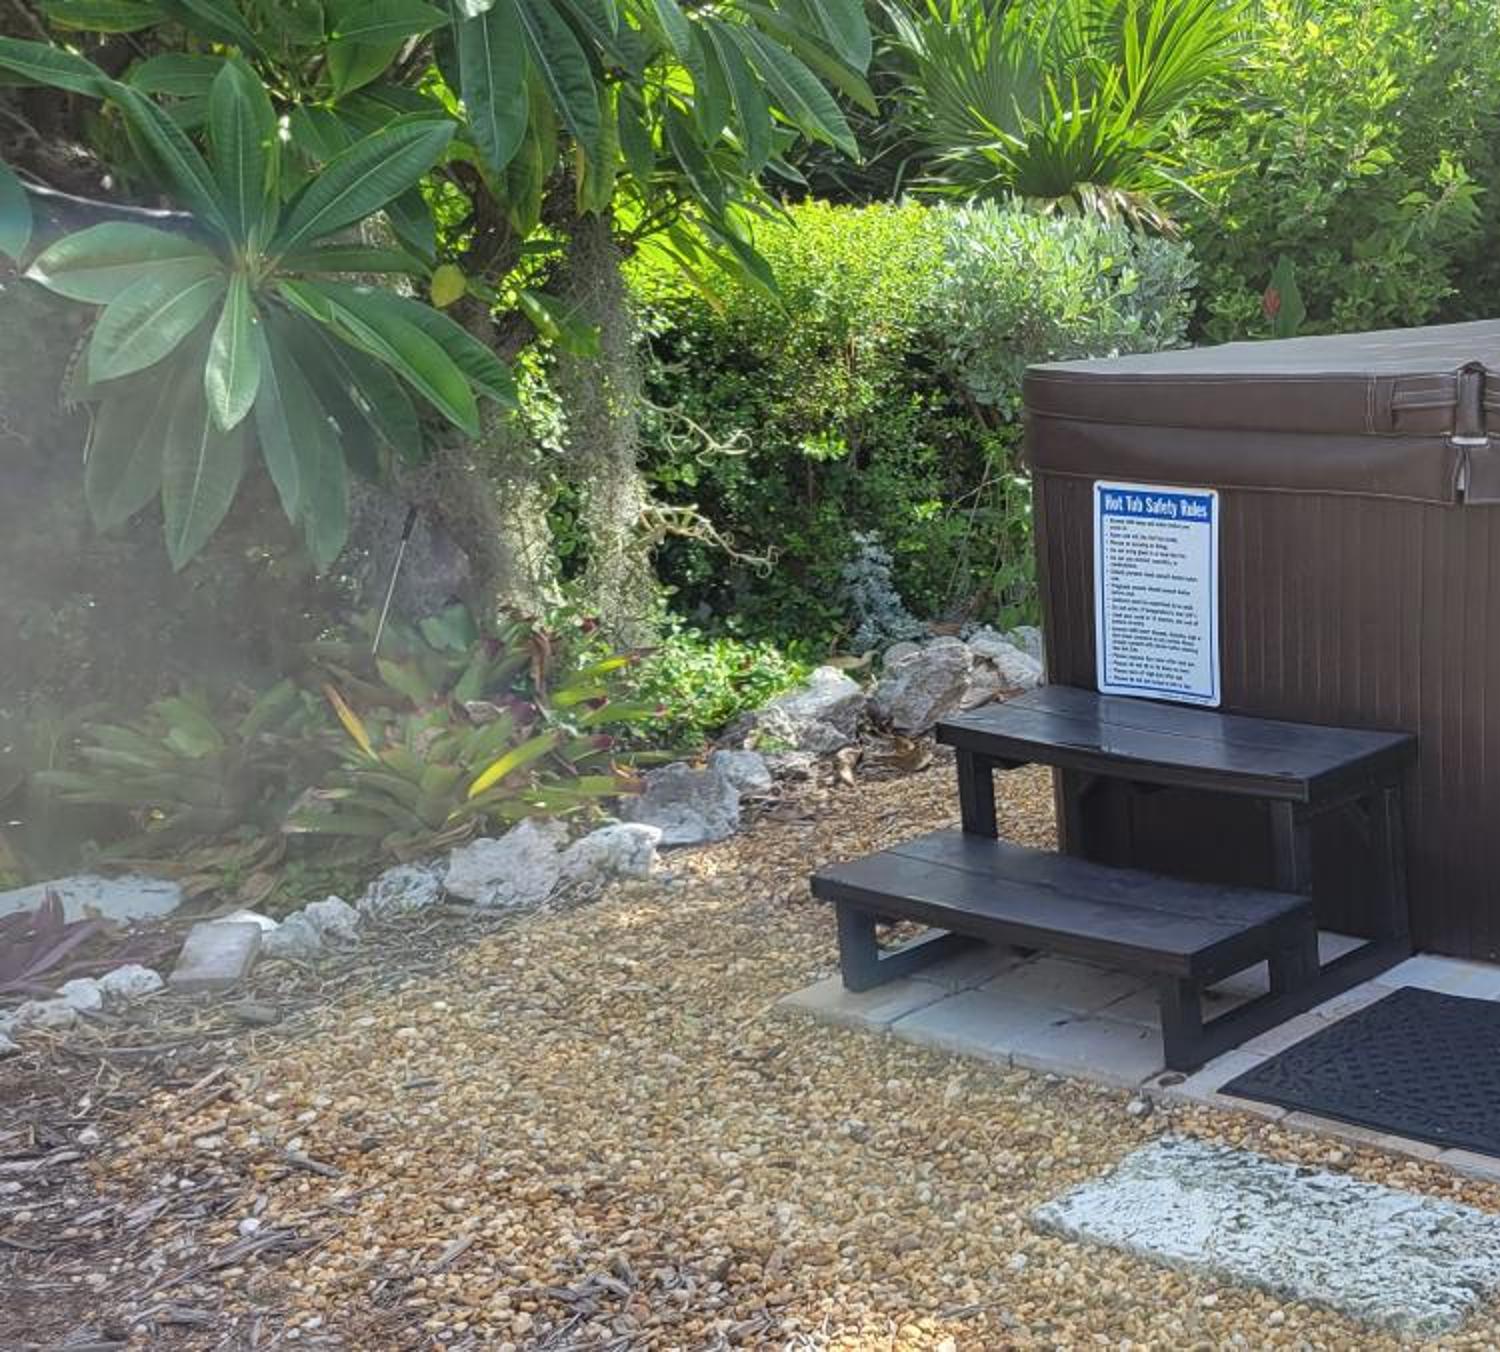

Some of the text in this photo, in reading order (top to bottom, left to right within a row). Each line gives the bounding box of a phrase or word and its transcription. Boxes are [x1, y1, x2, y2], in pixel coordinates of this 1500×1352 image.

[1104, 494, 1208, 518] Hot Tub Safety Rules
